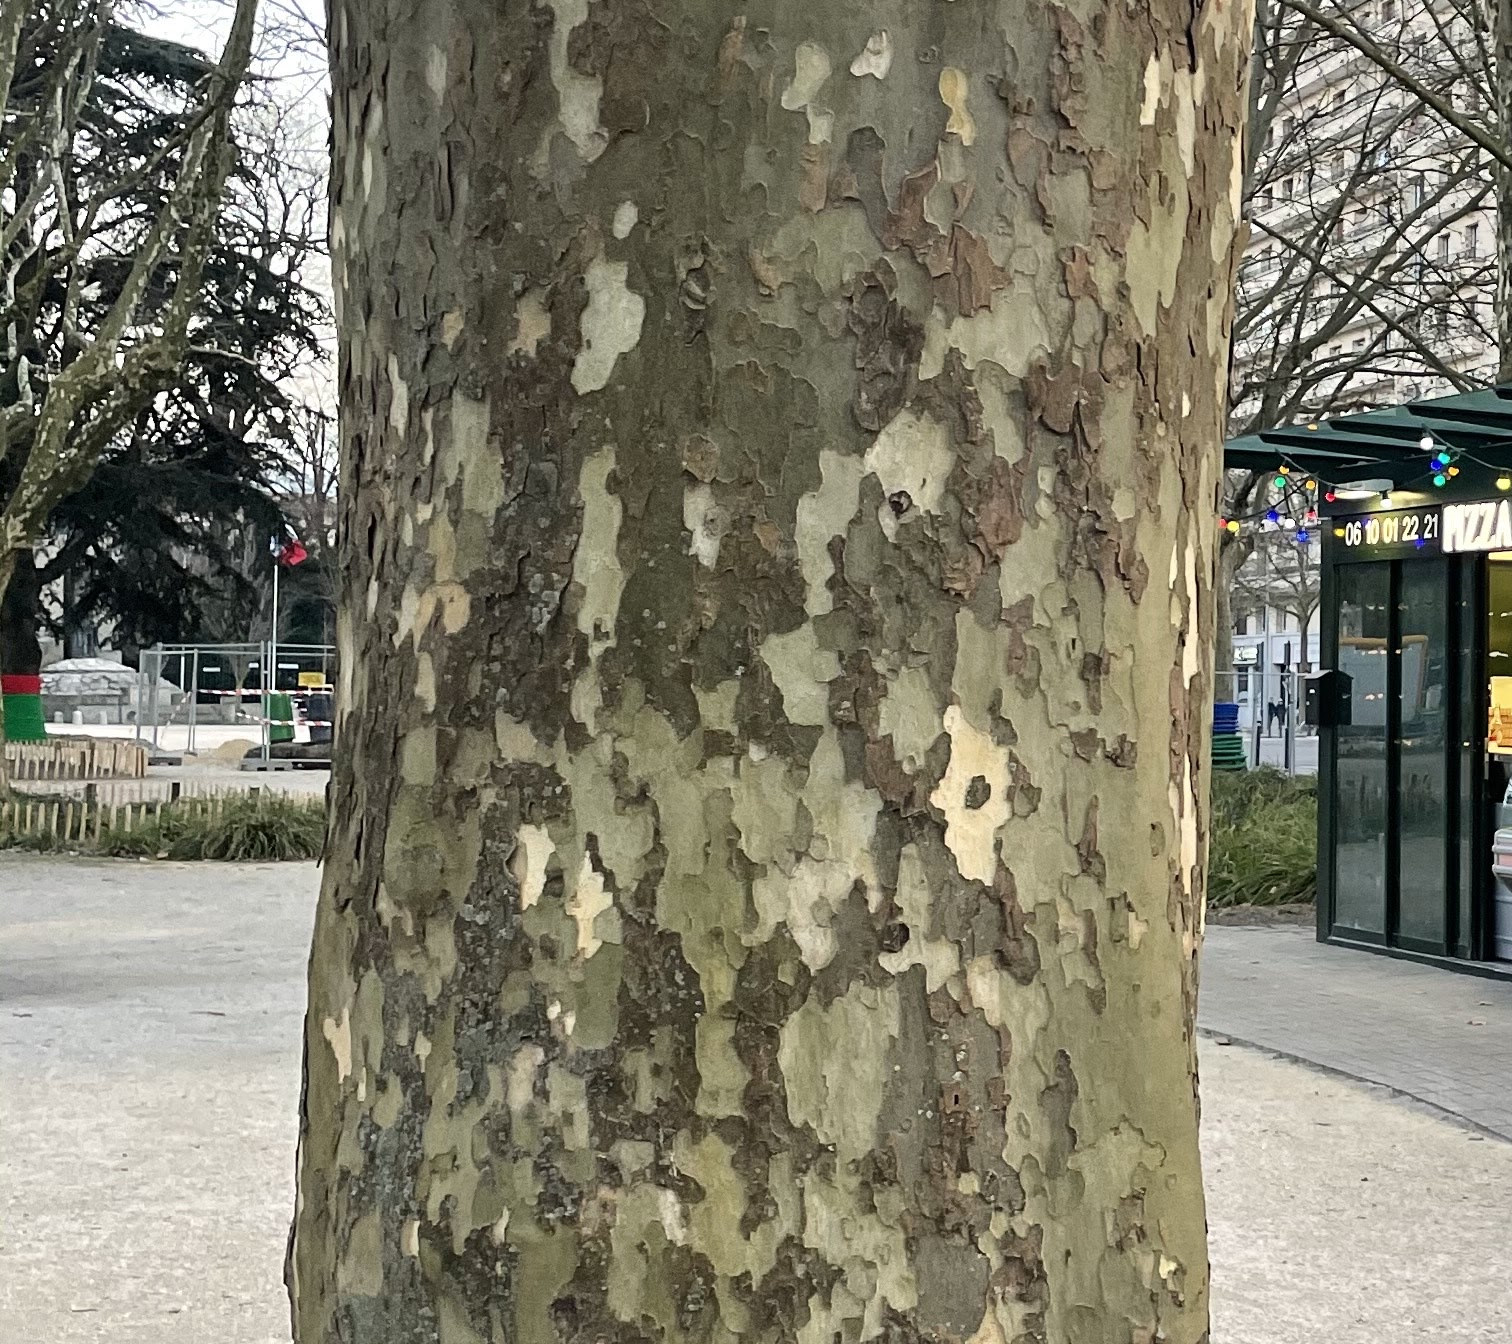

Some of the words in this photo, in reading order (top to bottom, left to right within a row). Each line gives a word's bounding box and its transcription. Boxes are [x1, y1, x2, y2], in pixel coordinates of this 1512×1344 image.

[1344, 520, 1362, 546] 06
[1365, 518, 1379, 545] 10
[1382, 516, 1398, 544] 01
[1402, 515, 1419, 542] 22
[1423, 513, 1439, 539] 21
[1443, 499, 1512, 553] PIZZA
